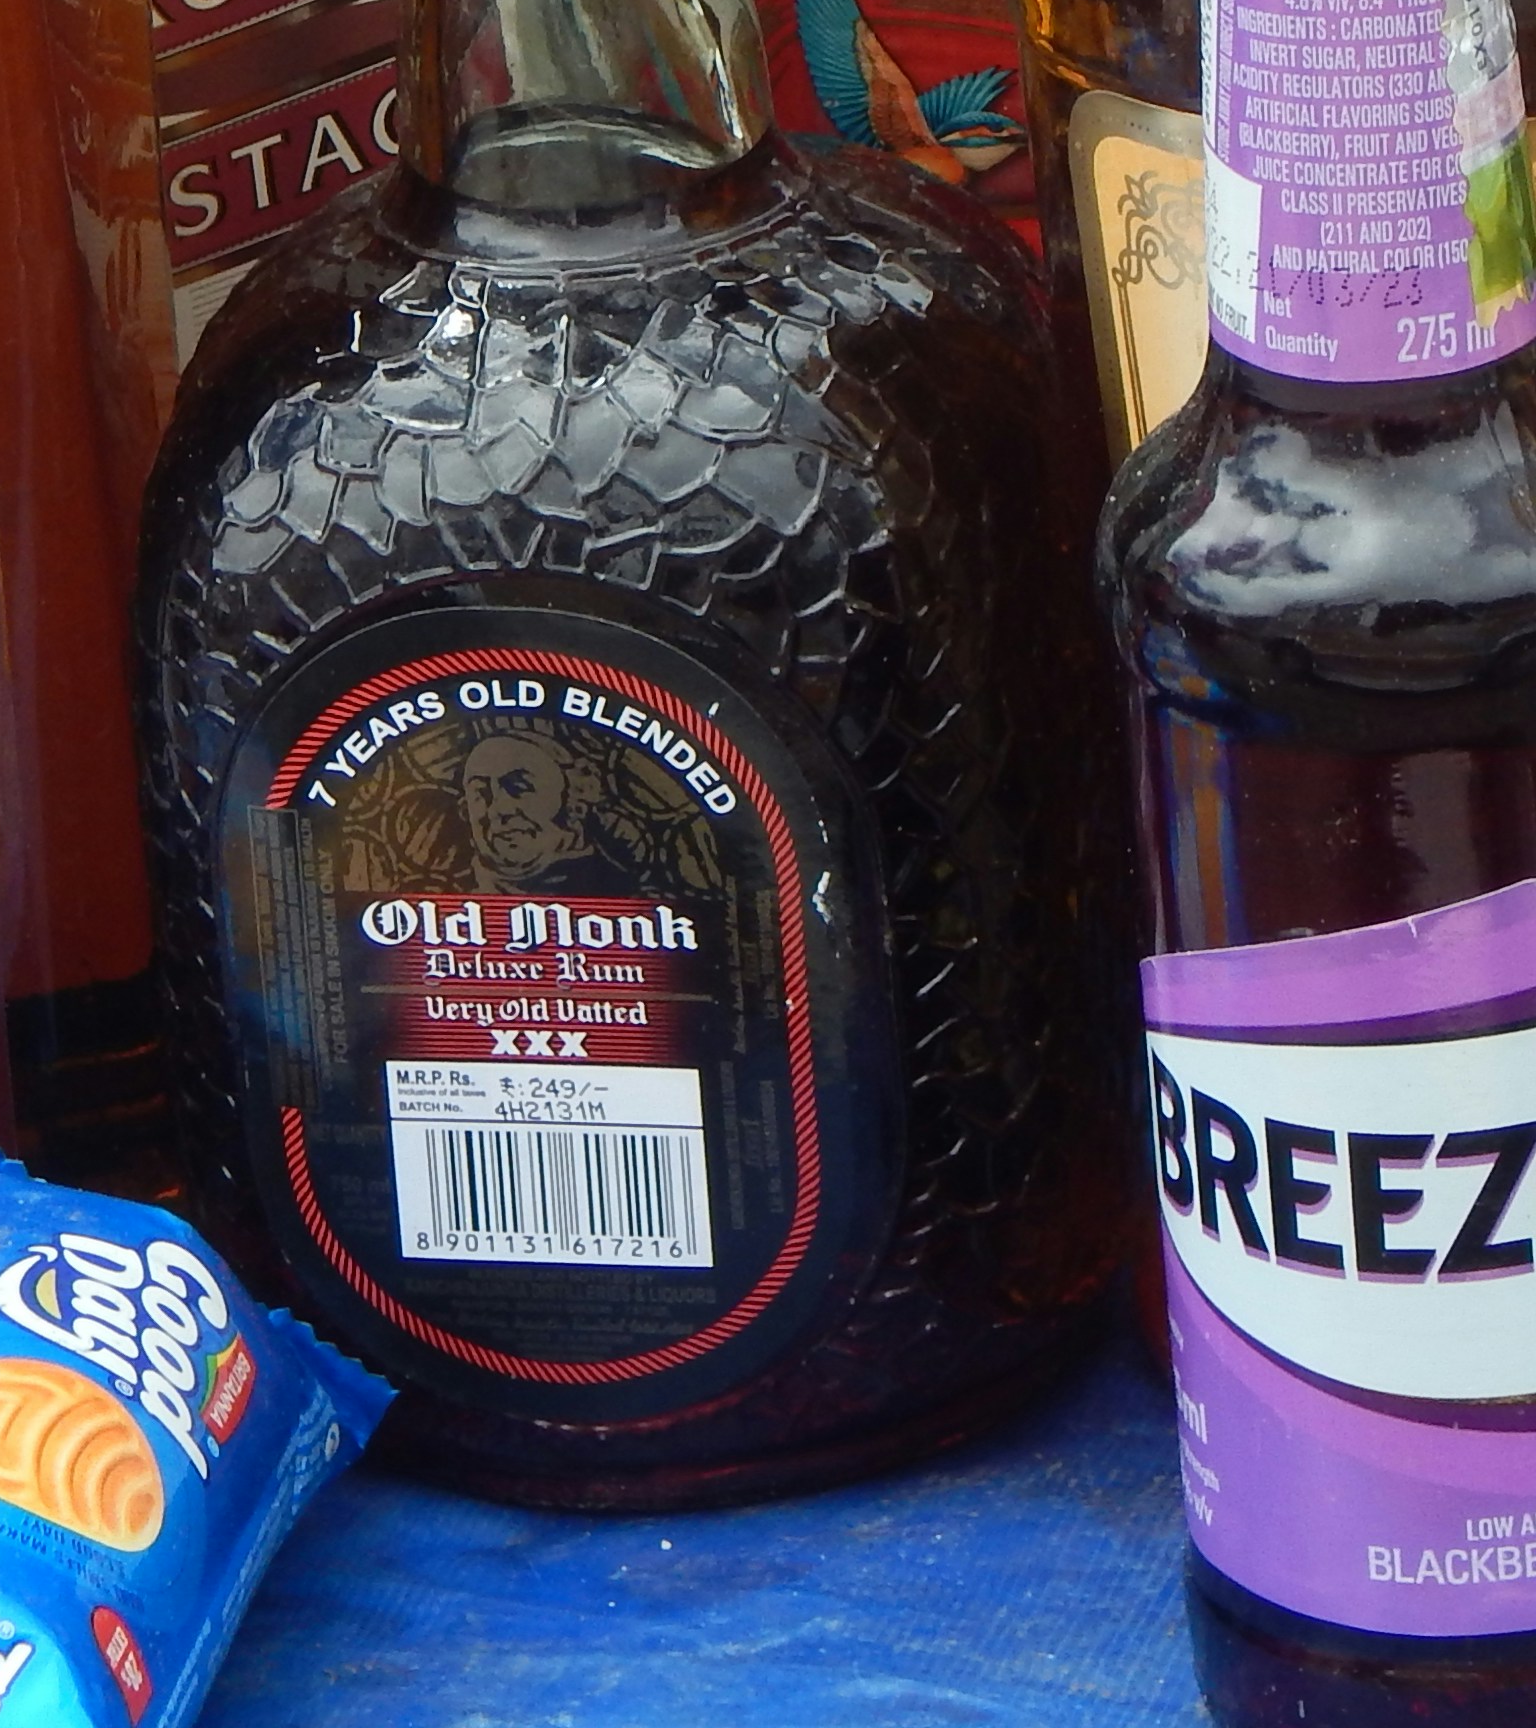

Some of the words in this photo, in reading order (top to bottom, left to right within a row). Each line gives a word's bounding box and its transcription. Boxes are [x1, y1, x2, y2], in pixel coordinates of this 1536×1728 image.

[1265, 325, 1339, 362] Quantity
[1396, 312, 1457, 364] 275
[308, 780, 338, 810] 7
[325, 690, 447, 784] YEARS
[459, 679, 546, 709] OLD
[563, 688, 738, 817] BLENDED
[361, 899, 487, 948] Old
[504, 902, 700, 954] Monk
[423, 950, 544, 988] Deluxe
[556, 953, 646, 990] Rum
[425, 996, 494, 1025] Very
[499, 997, 550, 1023] Old
[557, 998, 649, 1027] Vatted
[490, 1030, 589, 1058] XXX
[396, 1070, 446, 1087] M.R.P.
[449, 1071, 476, 1087] Rs.
[494, 1102, 607, 1122] 4H2131M
[140, 1241, 228, 1480] Good
[209, 1352, 252, 1429] BRITANNIA
[1466, 1515, 1513, 1542] LOW
